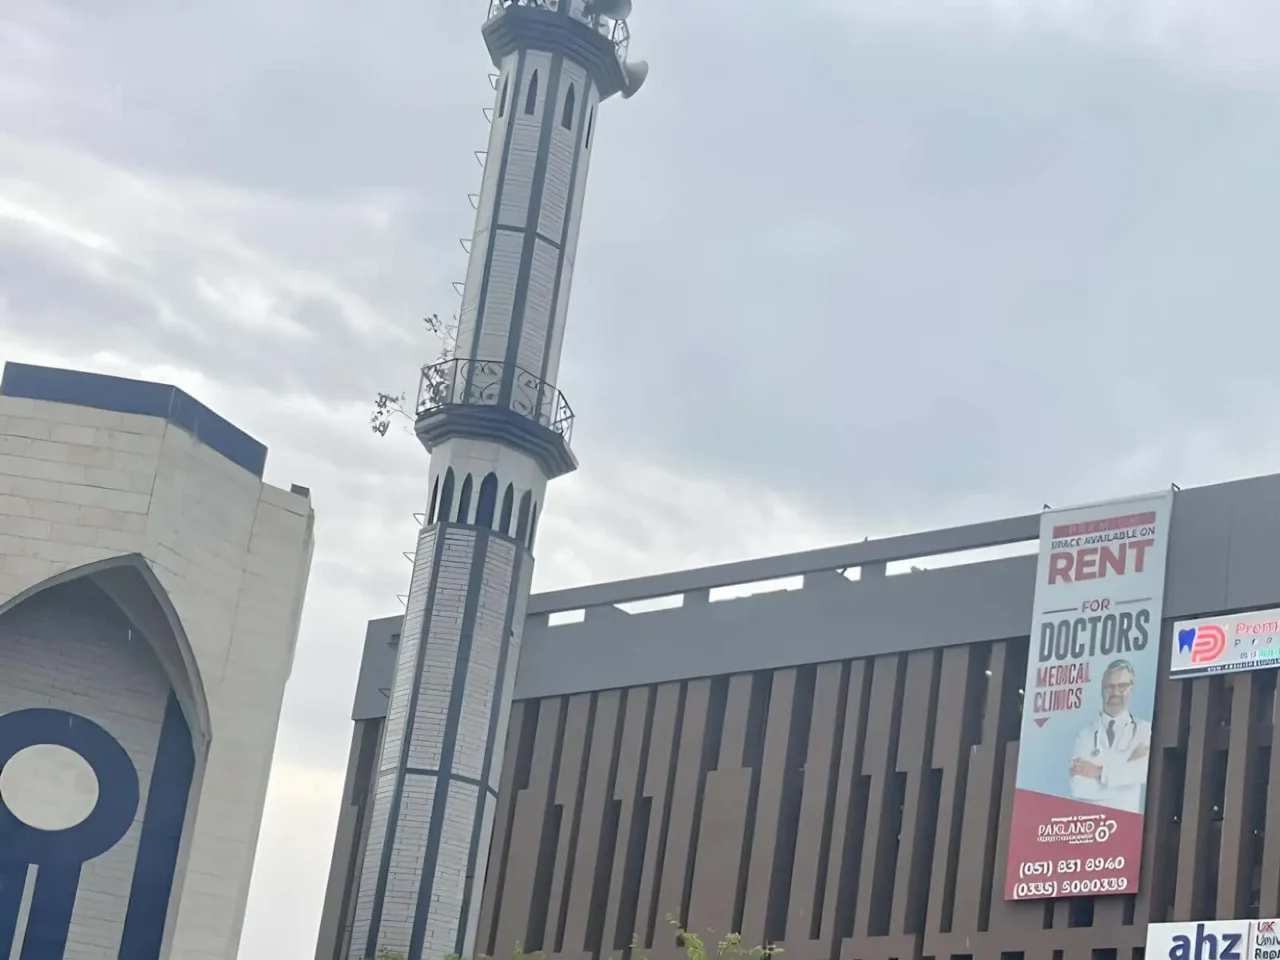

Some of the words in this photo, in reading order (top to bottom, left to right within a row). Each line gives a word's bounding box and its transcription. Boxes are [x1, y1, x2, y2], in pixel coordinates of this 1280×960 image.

[1139, 526, 1156, 537] ON
[1047, 538, 1155, 585] RENT
[1082, 598, 1111, 613] FOR
[1038, 608, 1150, 663] DOCTORS
[1034, 662, 1092, 689] MEDICAL
[1032, 688, 1083, 714] CLINICS
